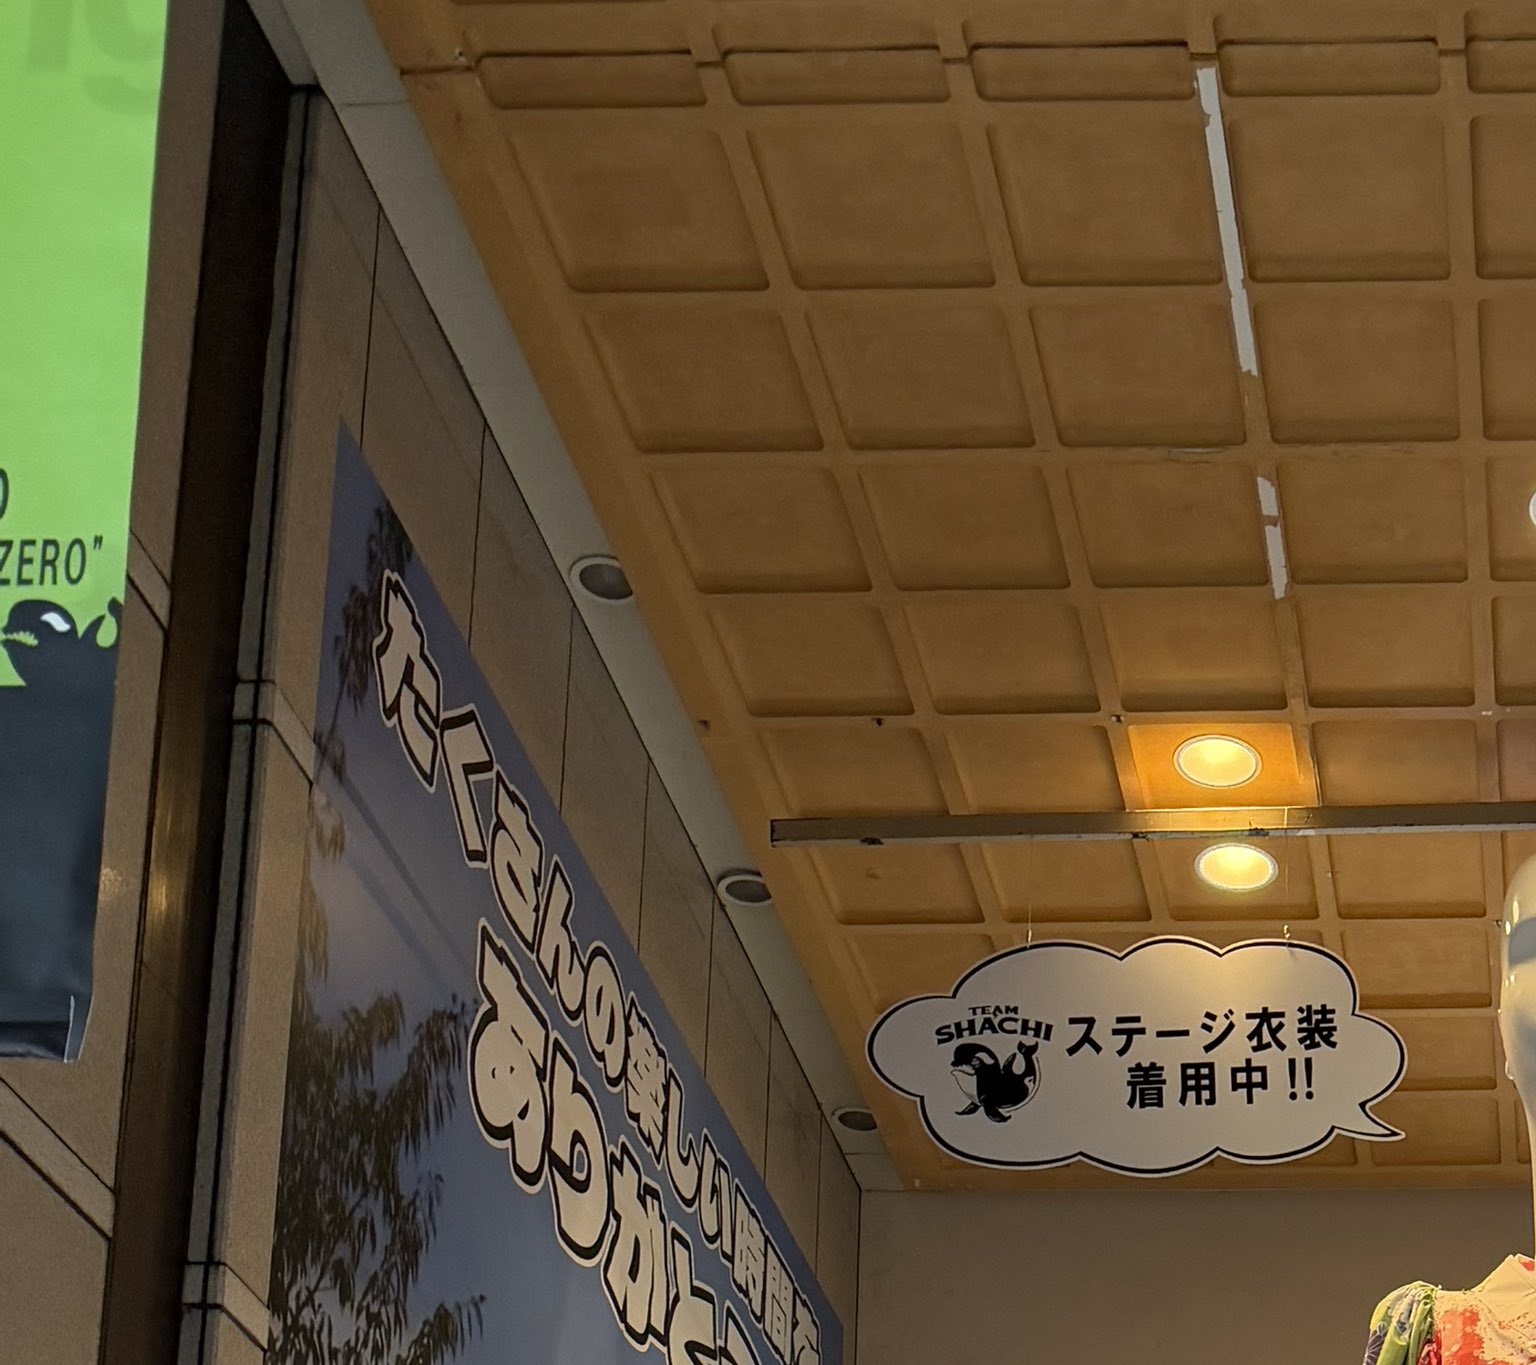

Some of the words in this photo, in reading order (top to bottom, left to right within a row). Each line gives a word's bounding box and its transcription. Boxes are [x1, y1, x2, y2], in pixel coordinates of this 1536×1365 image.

[968, 1005, 1019, 1017] TEAM
[935, 1016, 1054, 1047] SHACHI
[1065, 1005, 1339, 1057] ステージ衣装
